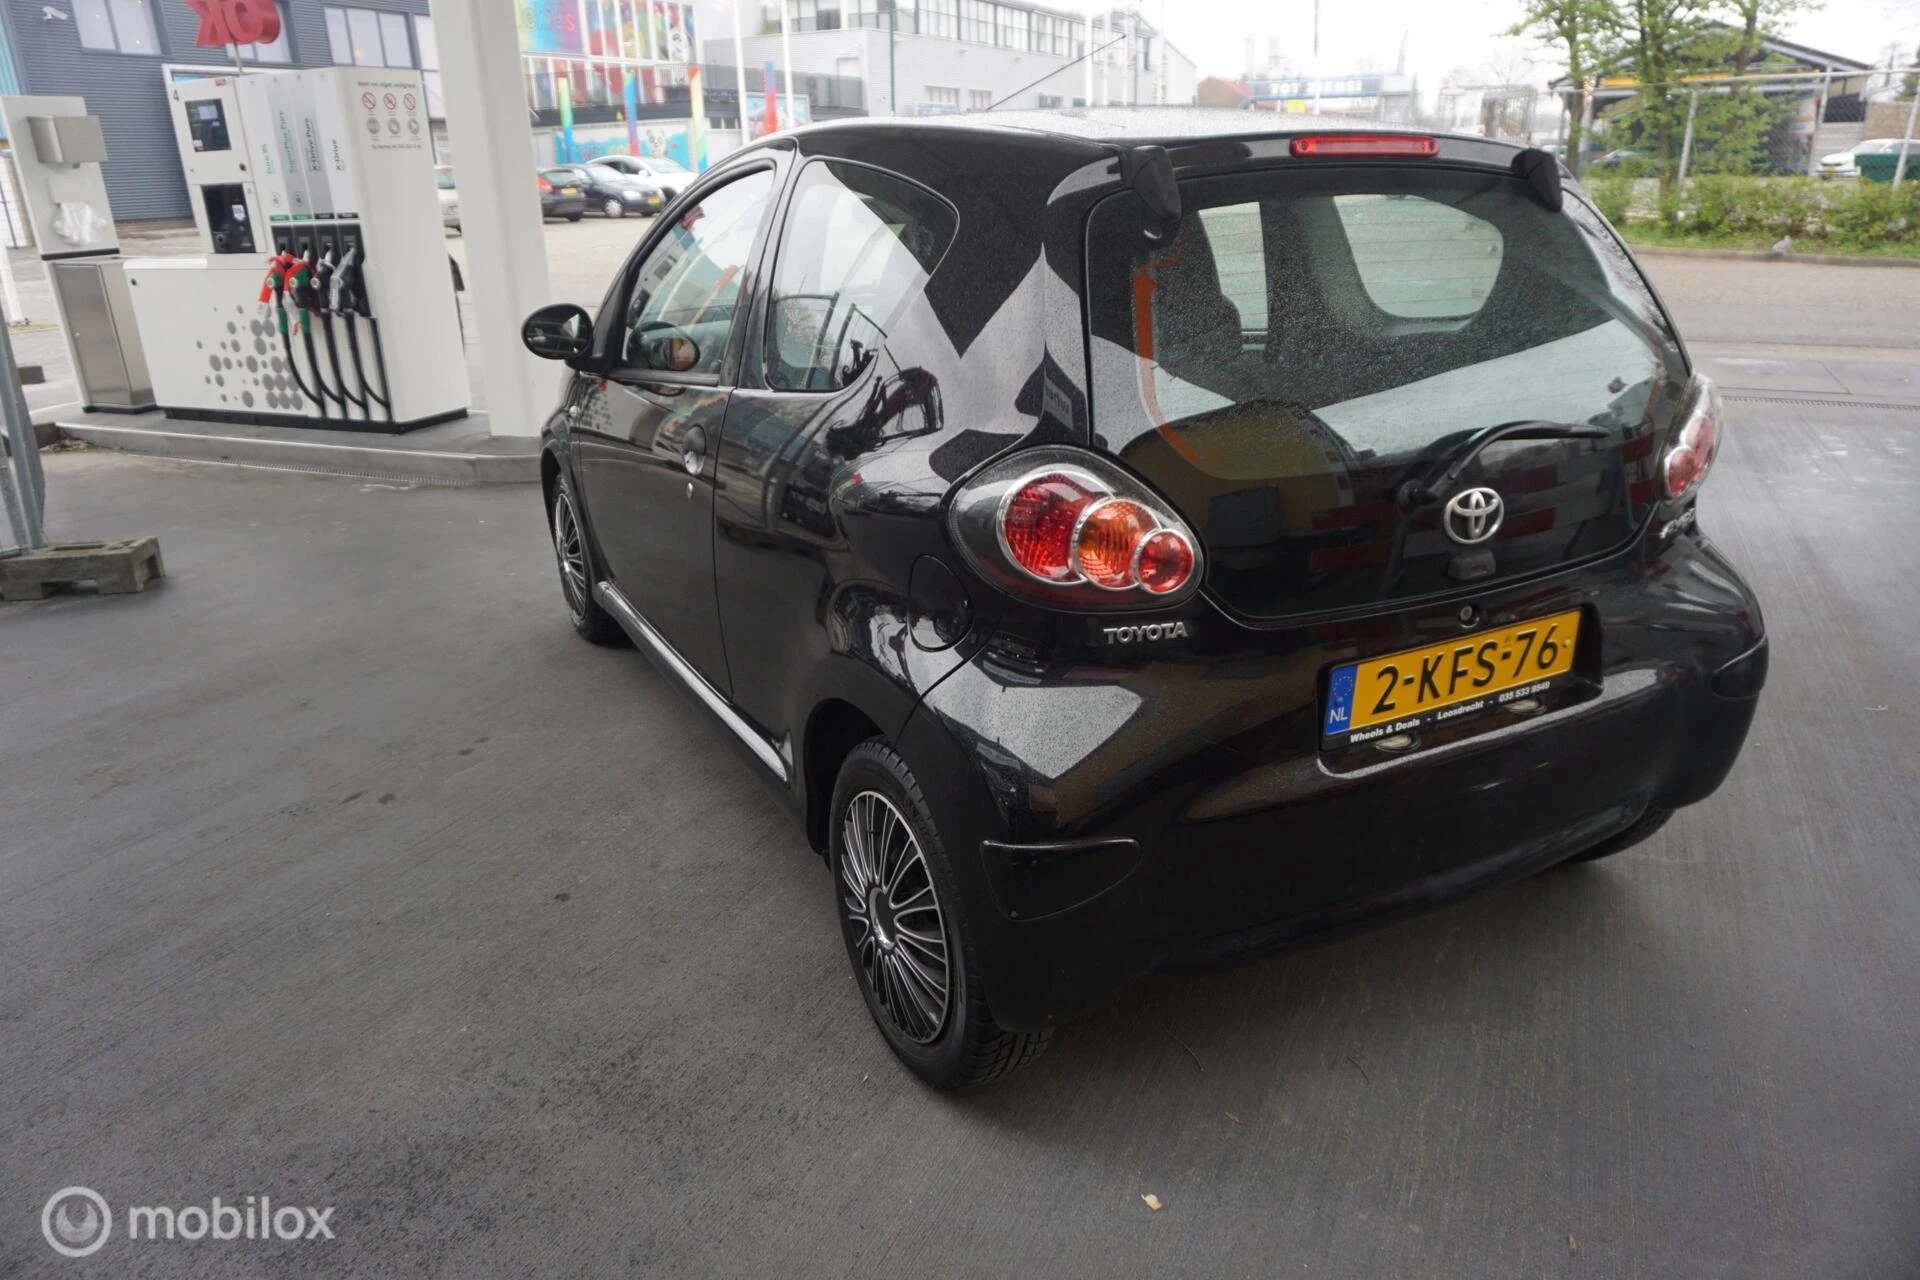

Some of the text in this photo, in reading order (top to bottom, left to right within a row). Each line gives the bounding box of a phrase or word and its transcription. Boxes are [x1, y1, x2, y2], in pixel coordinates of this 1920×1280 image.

[172, 89, 180, 101] 4
[1103, 621, 1189, 645] TOYOTA
[1372, 624, 1559, 714] 2-KFS-76
[1329, 707, 1348, 725] NL
[1350, 727, 1384, 744] Wheels
[1385, 724, 1393, 734] &
[1395, 717, 1420, 731] Deals
[1437, 700, 1484, 720] Loosdrecht
